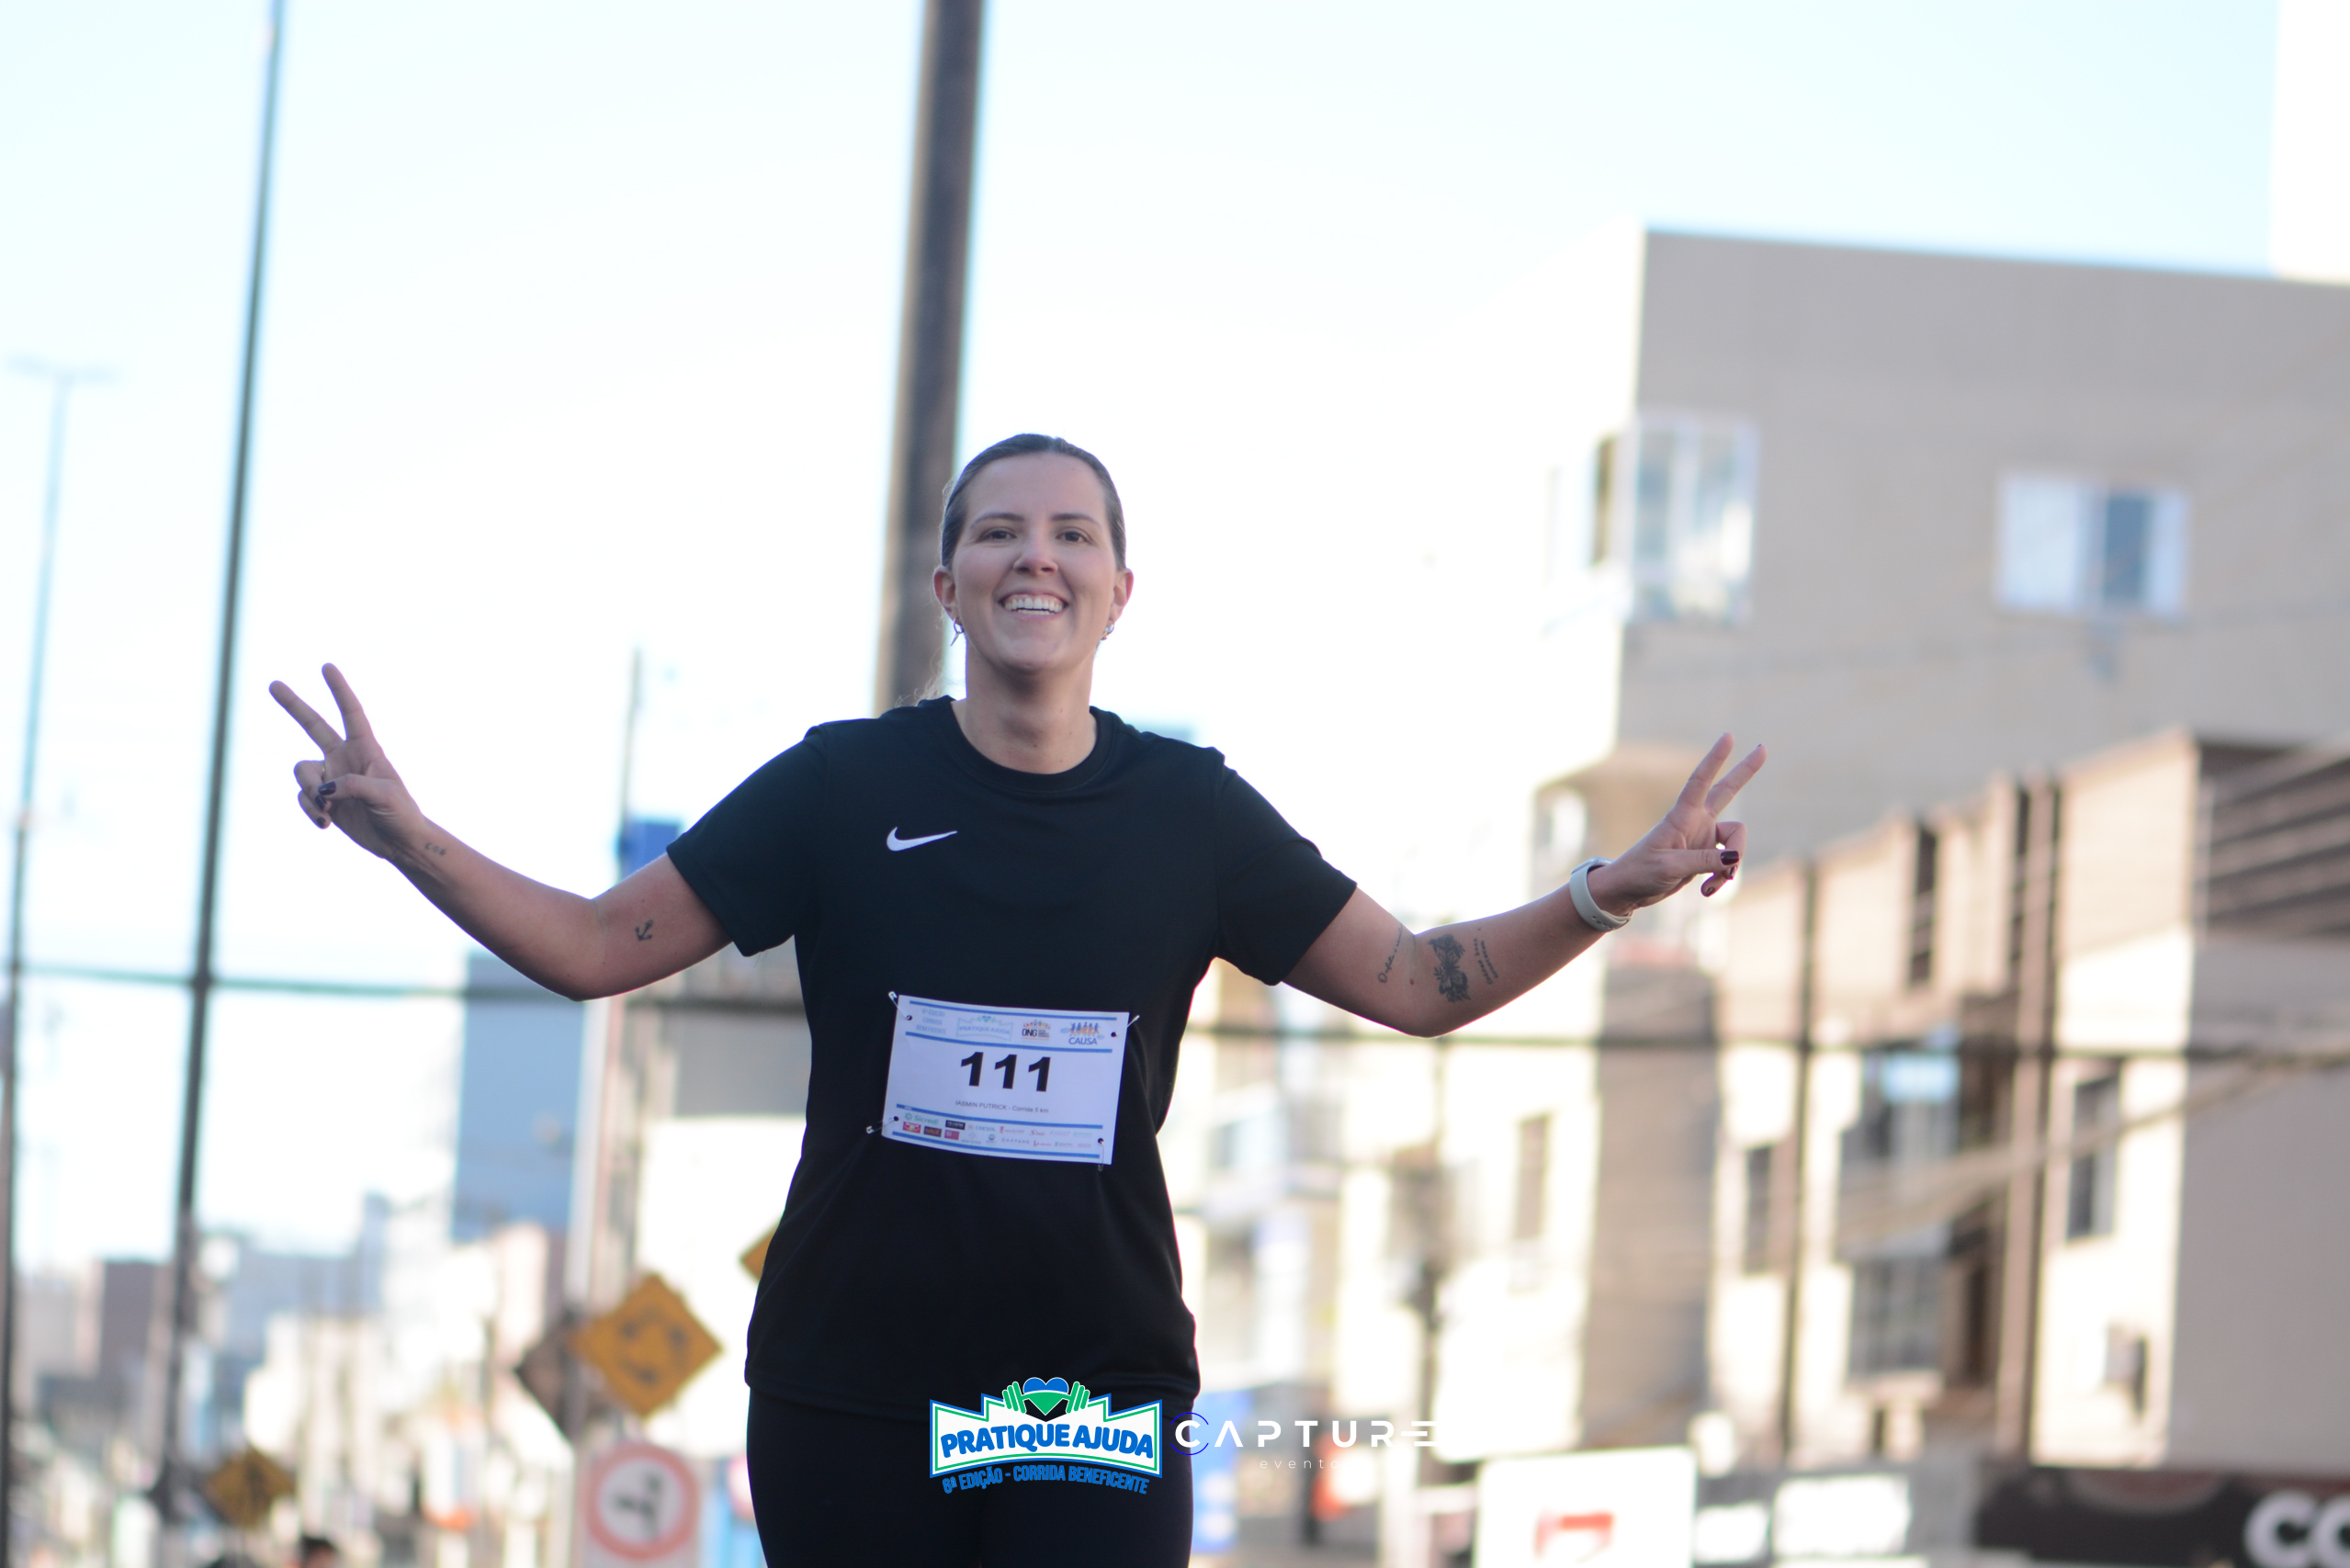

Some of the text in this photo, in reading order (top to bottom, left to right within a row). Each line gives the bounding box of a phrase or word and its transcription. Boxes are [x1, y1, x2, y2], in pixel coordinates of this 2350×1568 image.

[1022, 1028, 1037, 1037] ONG
[1068, 1037, 1098, 1045] CAUSA
[960, 1051, 1051, 1092] 111
[979, 1102, 1008, 1111] PUTRICK
[914, 1115, 939, 1125] Sicredi
